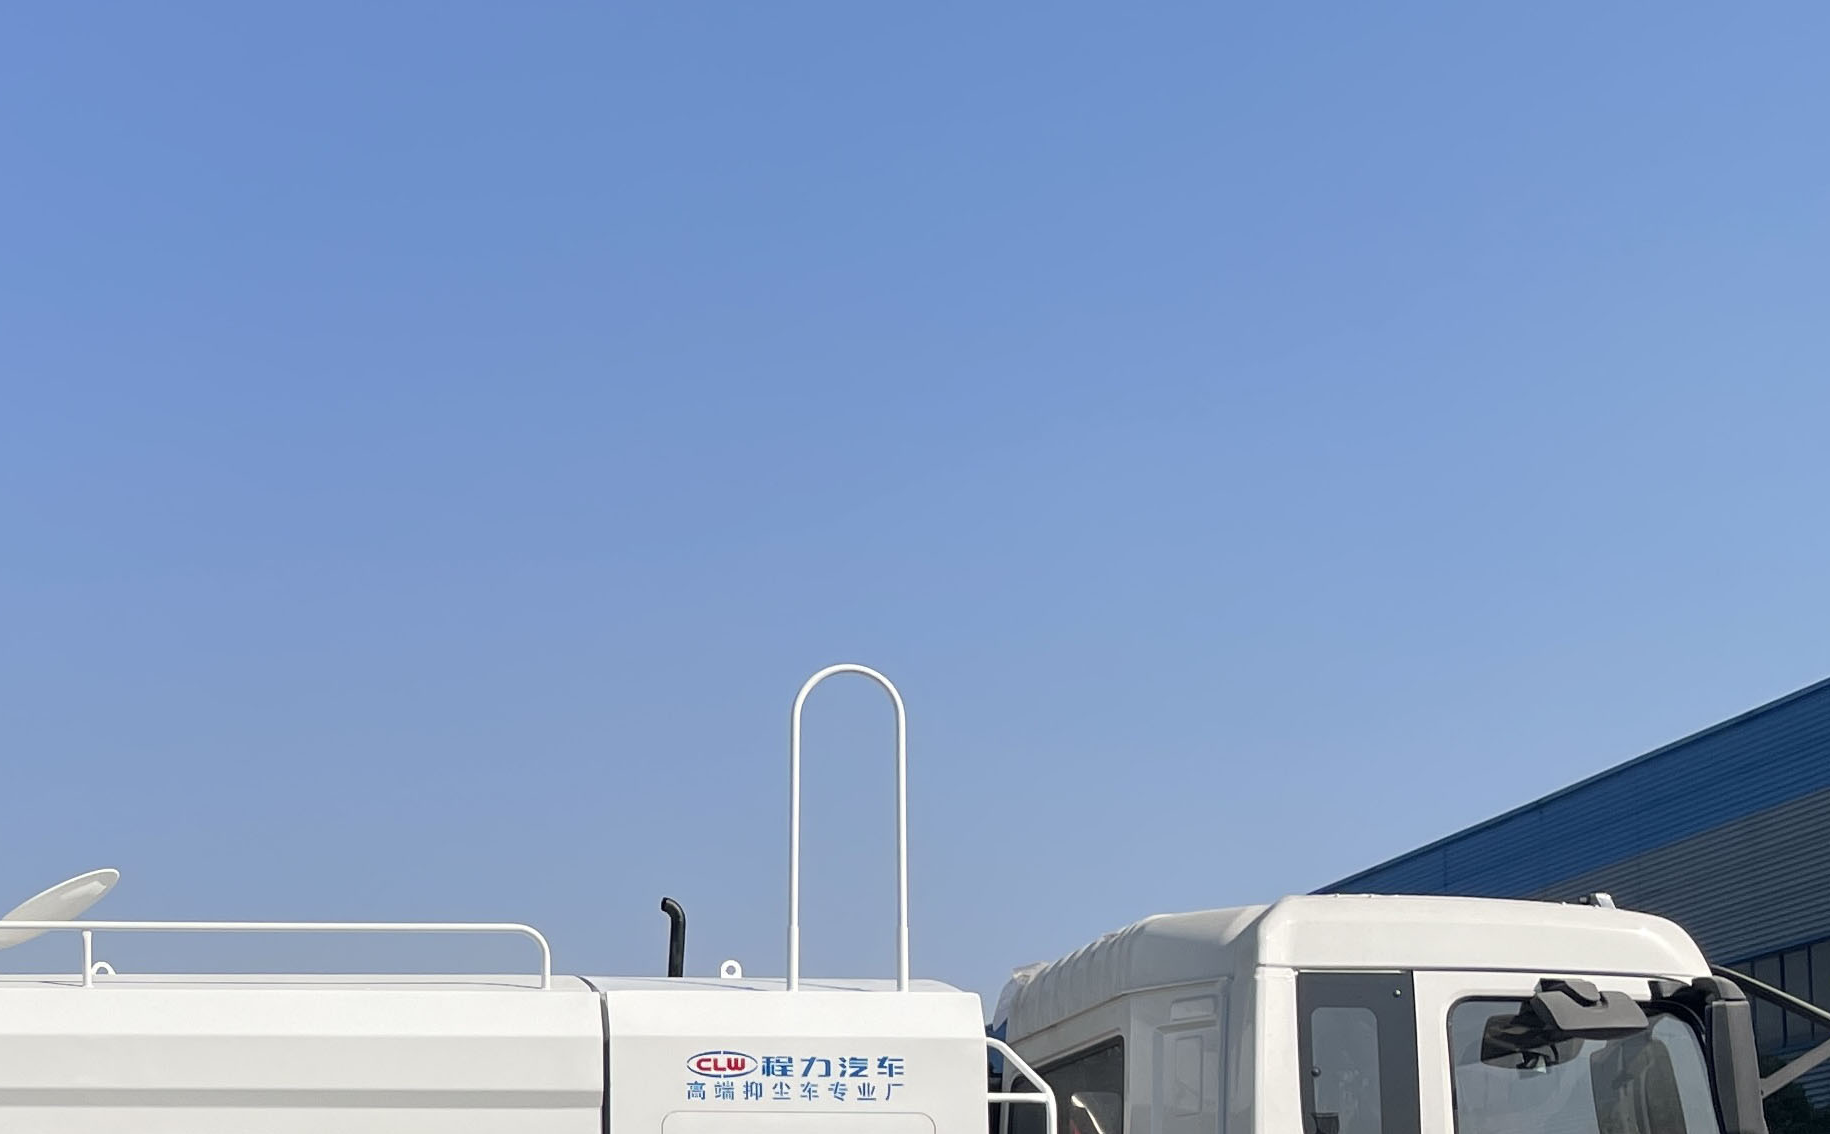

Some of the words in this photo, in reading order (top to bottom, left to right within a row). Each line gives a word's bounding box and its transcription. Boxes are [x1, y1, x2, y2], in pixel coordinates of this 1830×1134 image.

[695, 1056, 747, 1072] CLW
[761, 1055, 905, 1078] 程力汽车
[686, 1080, 905, 1101] 高端抑尘车专业厂
